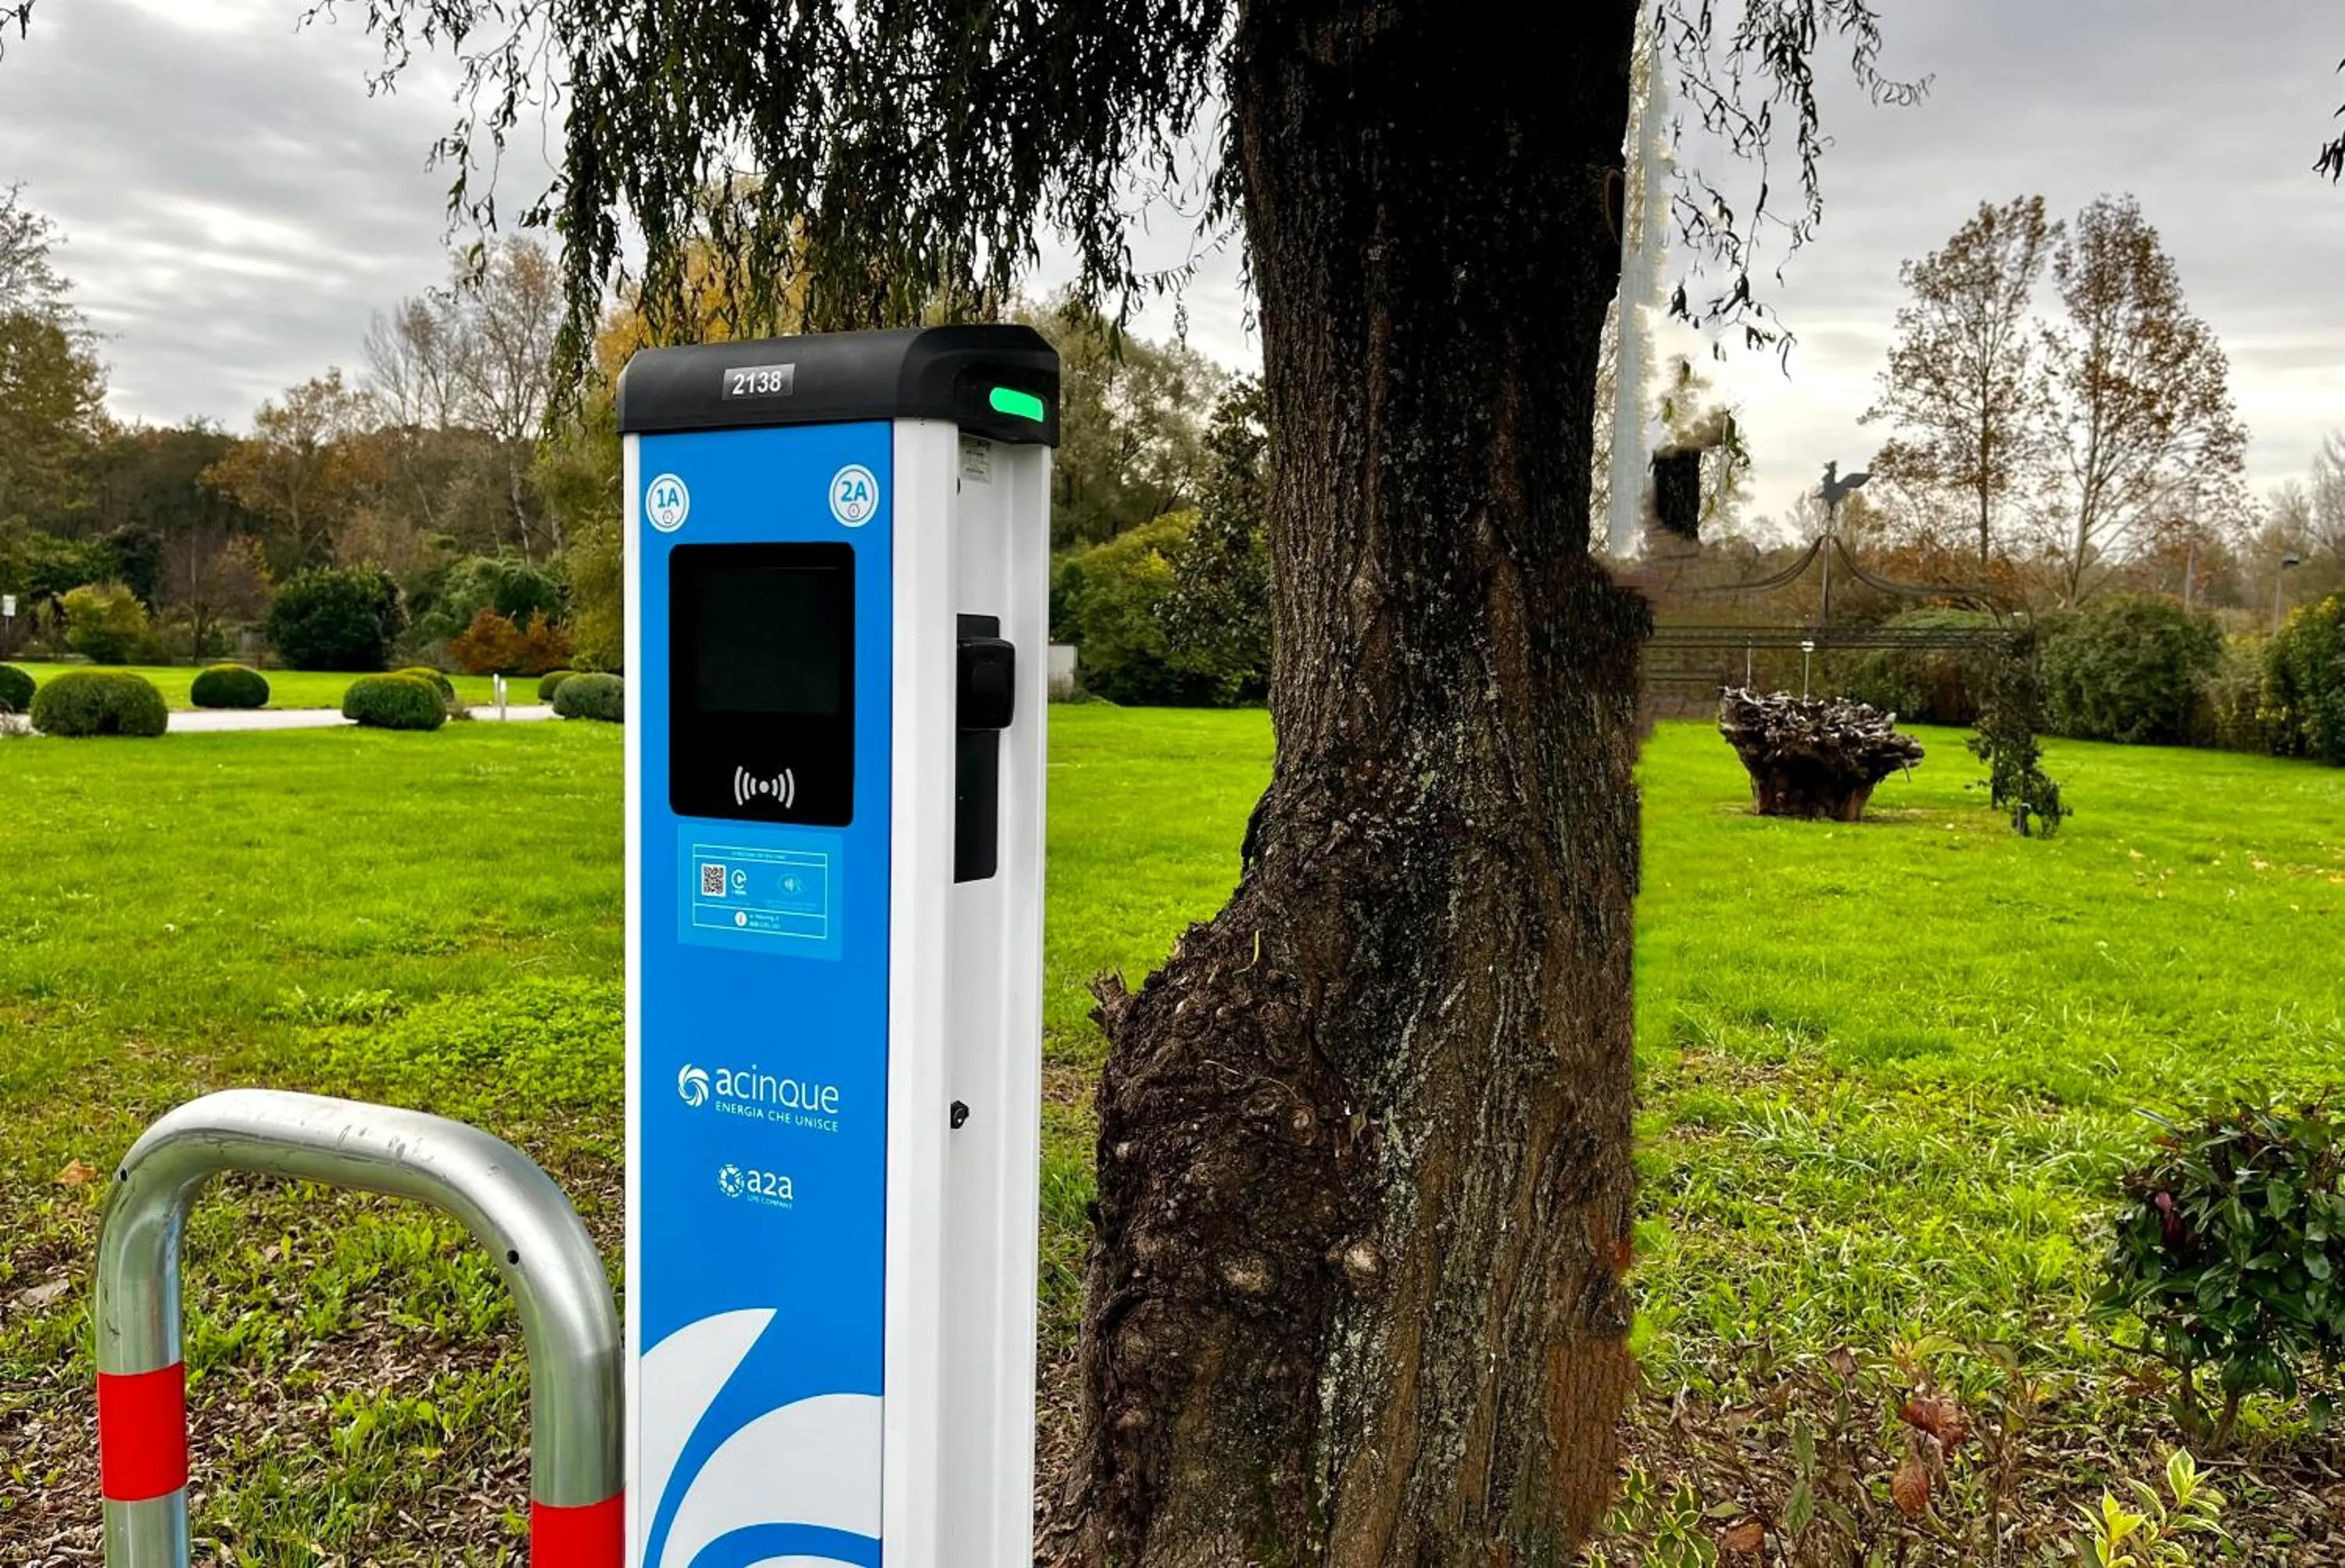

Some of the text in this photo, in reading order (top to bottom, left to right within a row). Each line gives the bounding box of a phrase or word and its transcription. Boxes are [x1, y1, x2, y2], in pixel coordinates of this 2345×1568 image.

[732, 371, 781, 395] 2138
[657, 488, 679, 508] 1A
[841, 481, 868, 501] 2A
[715, 1064, 839, 1114] acinque
[715, 1101, 839, 1133] ENERGIA CHE UNISCE
[746, 1170, 793, 1200] a2a
